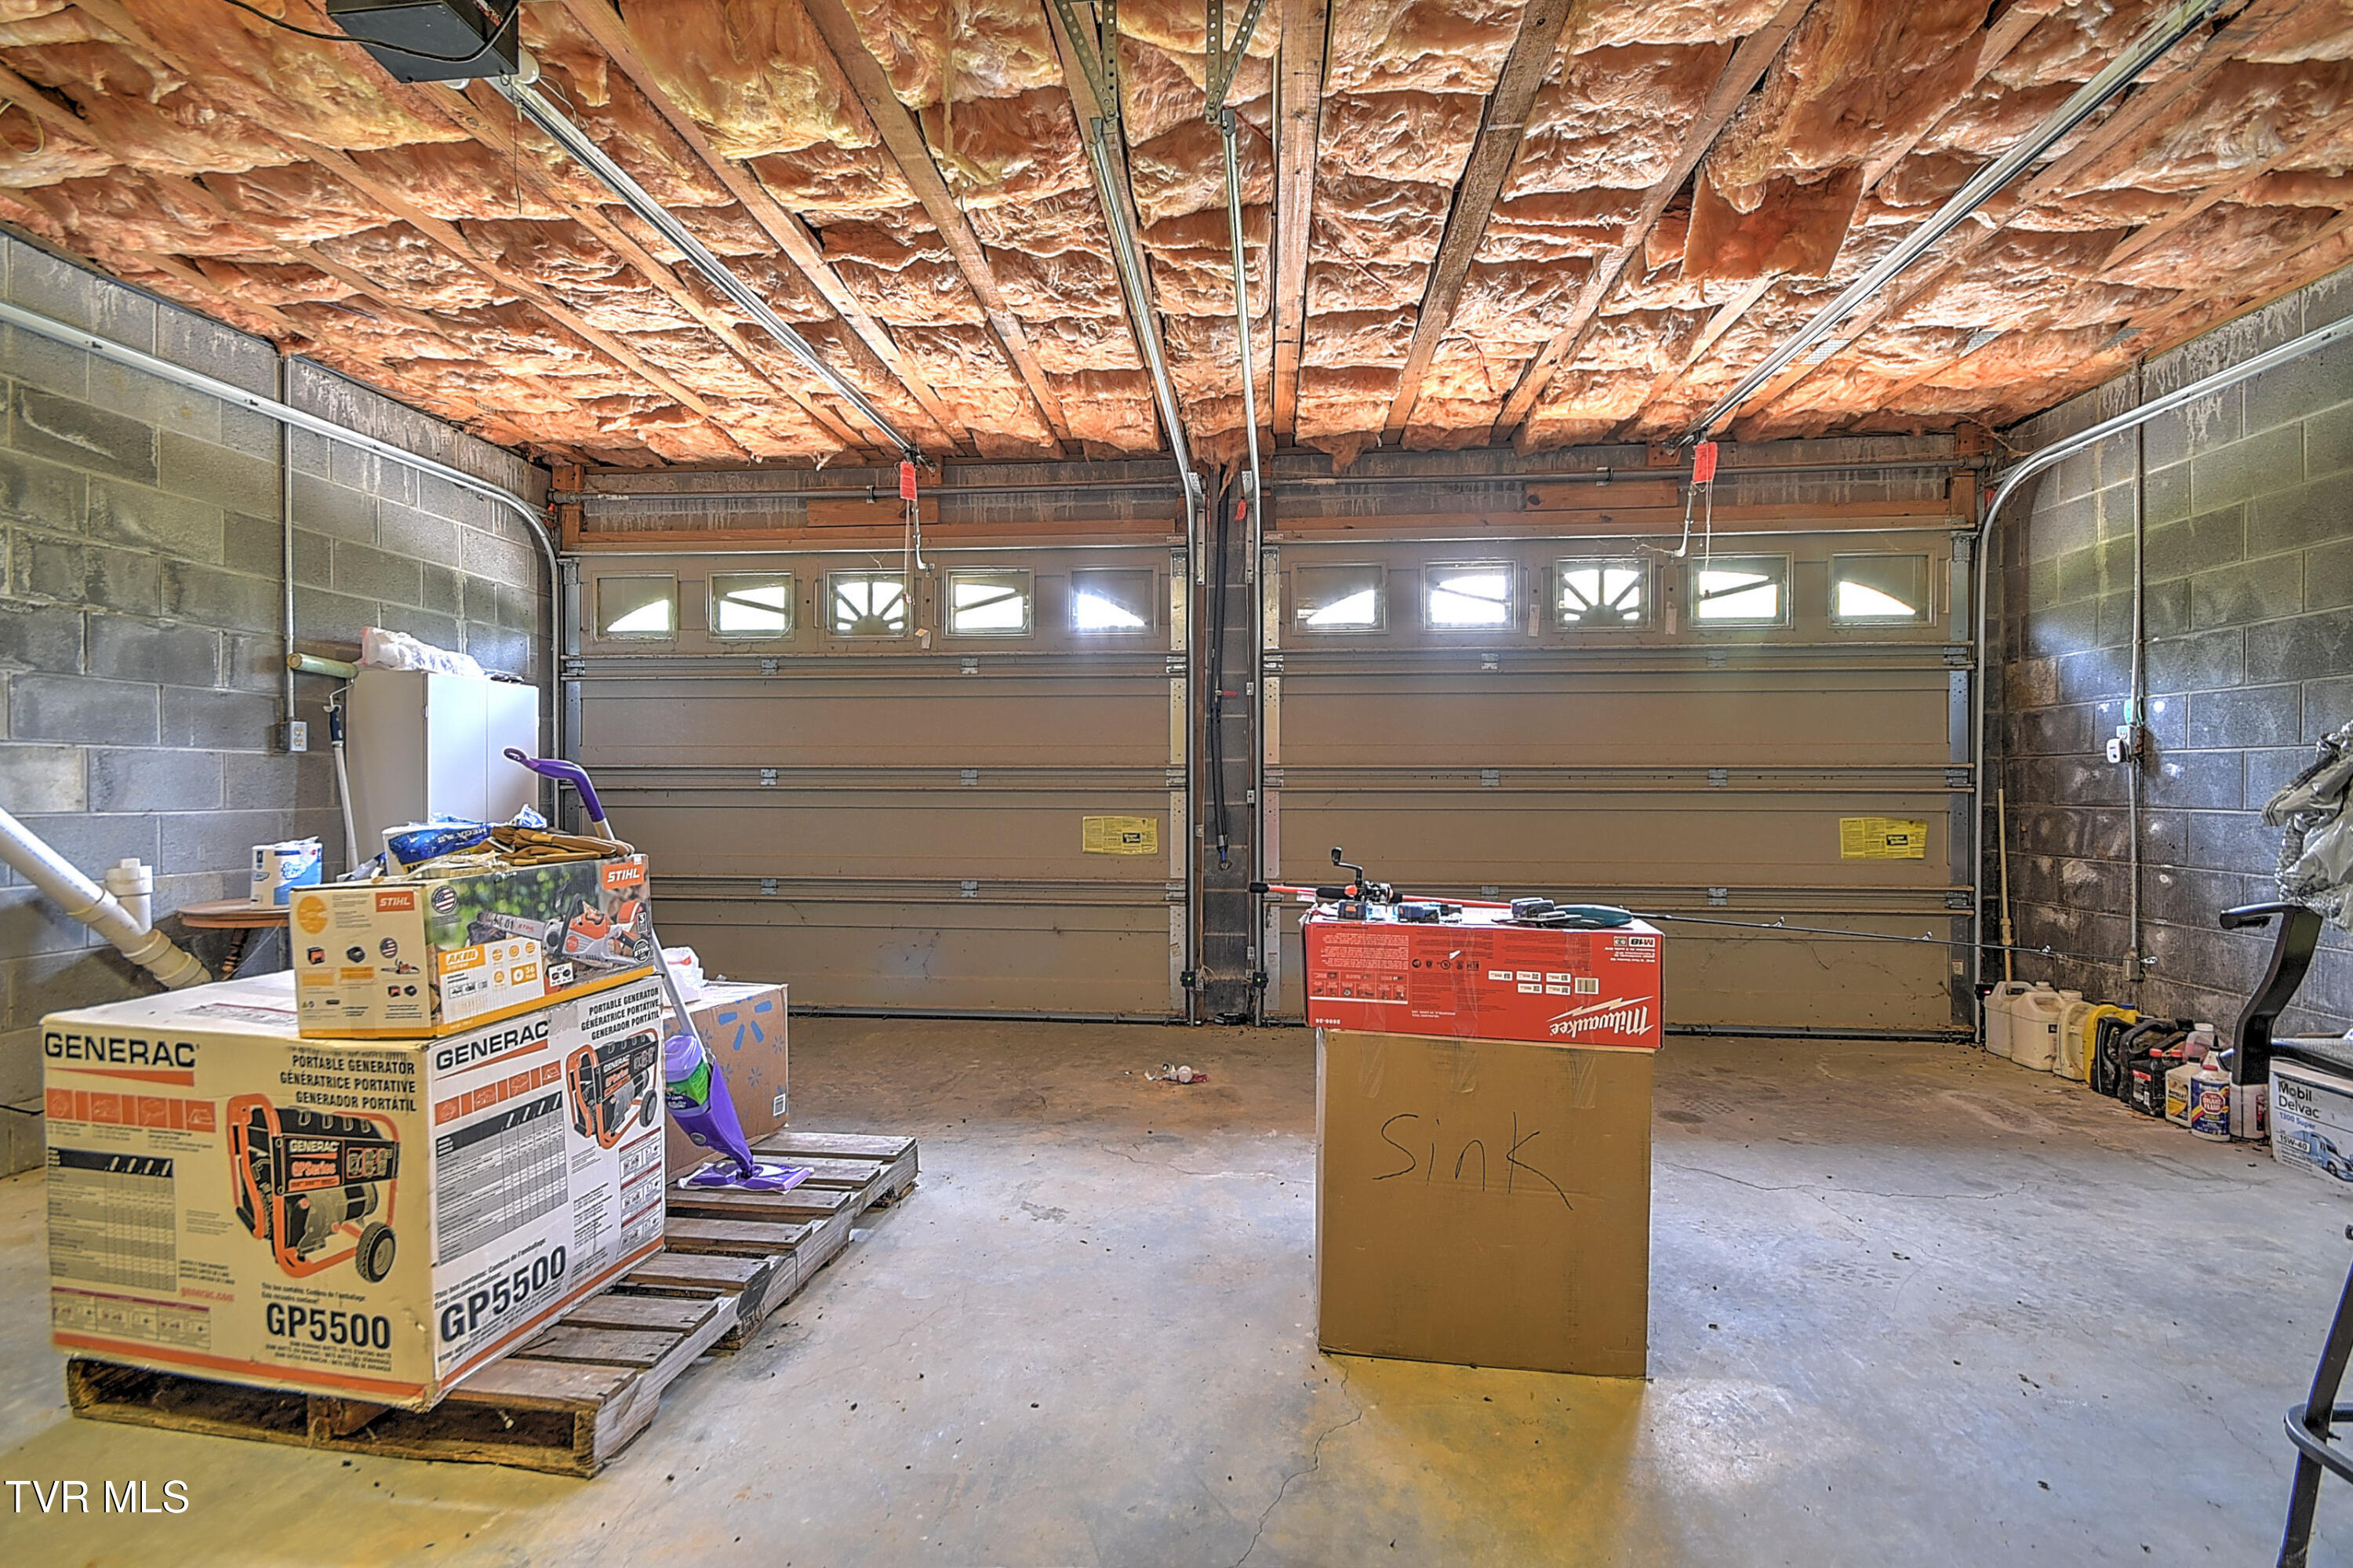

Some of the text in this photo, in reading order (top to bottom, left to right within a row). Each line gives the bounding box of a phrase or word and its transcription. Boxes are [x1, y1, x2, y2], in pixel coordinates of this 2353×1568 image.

[607, 868, 640, 883] STIHL
[380, 897, 411, 907] STIHL
[634, 944, 650, 957] STIHL
[1630, 937, 1654, 946] M18
[589, 988, 659, 1016] PORTABLE GENERATOR
[581, 999, 659, 1031] GÉNÉRATRICE PORTATIVE
[591, 1010, 660, 1041] GENERADOR PORTÁTIL
[1549, 1006, 1654, 1039] Milwaukee
[45, 1032, 196, 1068] GENERAC
[436, 1020, 549, 1071] GENERAC
[292, 1054, 415, 1075] PORTABLE GENERATOR
[603, 1054, 631, 1073] GENERAC
[279, 1071, 416, 1094] GÉNÉRATRICE PORTATIVE
[2278, 1081, 2312, 1101] Mobil
[296, 1090, 417, 1112] GENERADOR PORTÁTIL
[2278, 1095, 2319, 1119] Delvac
[2279, 1111, 2315, 1130] 1300 Super
[289, 1140, 339, 1153] GENERAC
[2279, 1134, 2308, 1151] 15W-40
[1373, 1111, 1573, 1210] Sink
[441, 1246, 566, 1342] GP5500
[267, 1302, 391, 1350] GP5500
